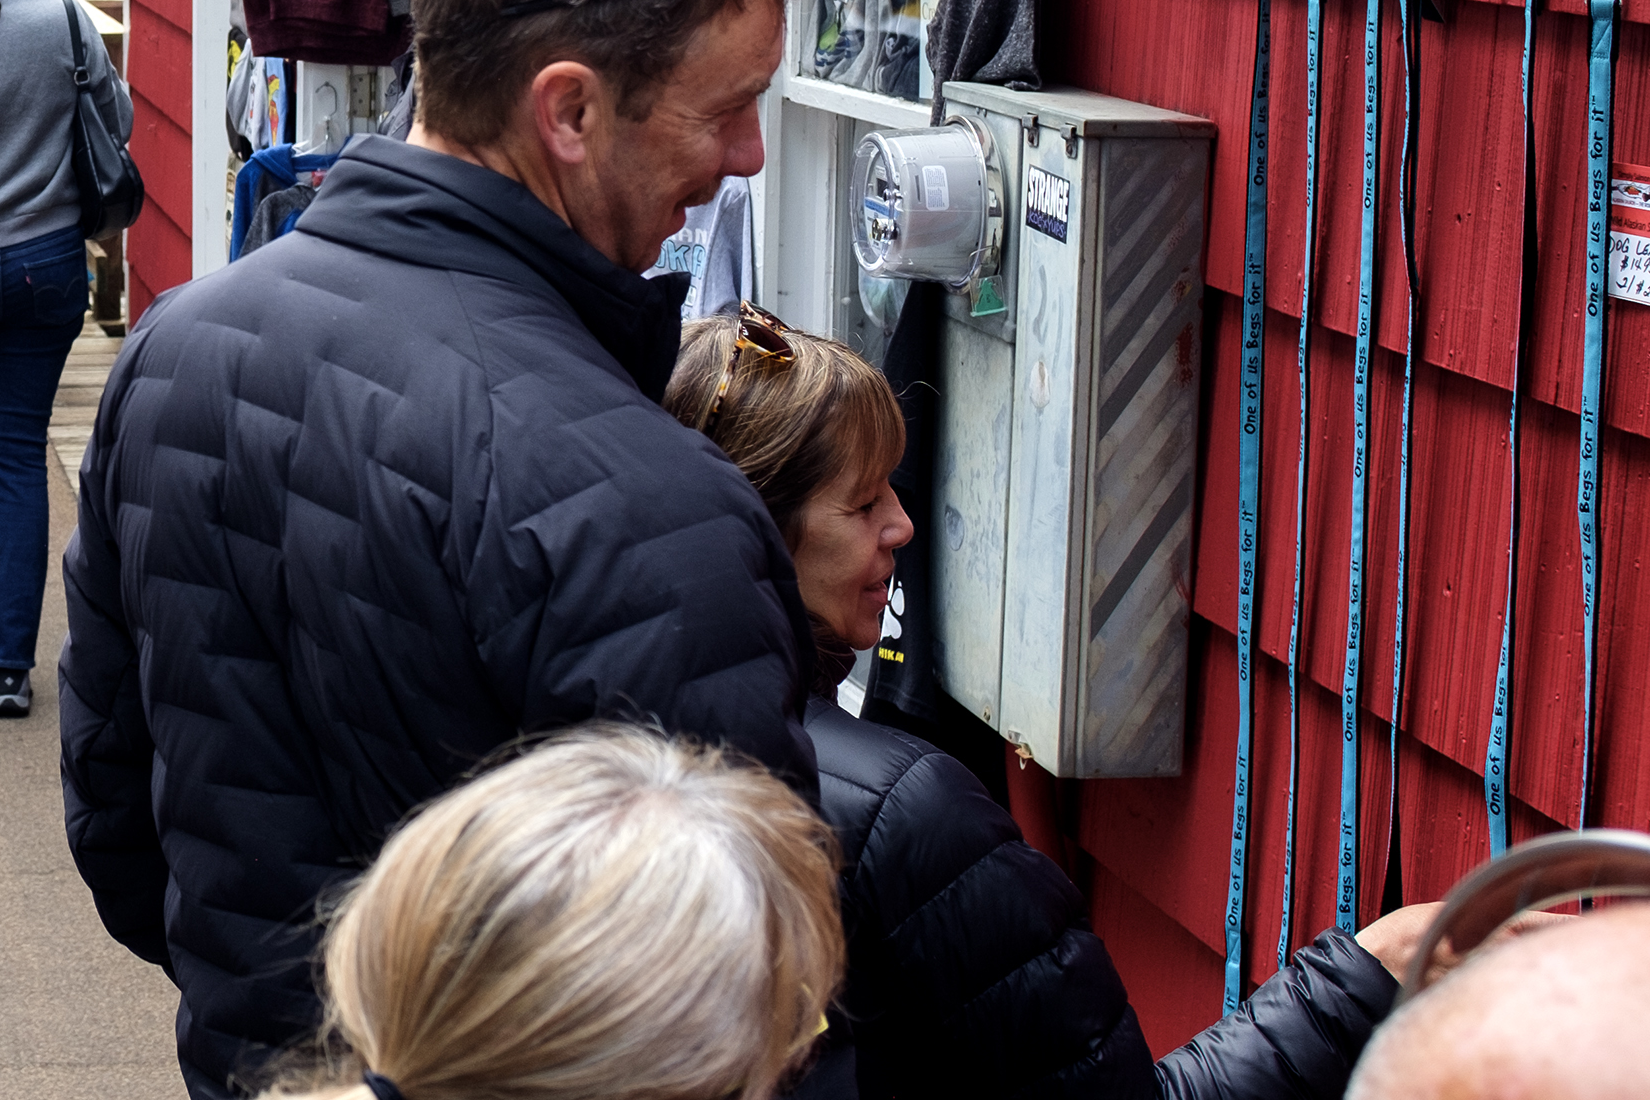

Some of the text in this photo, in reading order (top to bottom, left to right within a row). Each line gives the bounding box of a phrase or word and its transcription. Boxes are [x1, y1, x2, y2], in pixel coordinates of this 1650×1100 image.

[1365, 40, 1374, 66] for
[1366, 76, 1375, 114] Begs
[1365, 122, 1373, 141] us
[1590, 131, 1604, 160] for
[1365, 151, 1373, 170] of
[1028, 166, 1070, 223] STRANGE
[1364, 178, 1372, 208] One
[1590, 169, 1604, 212] Begs
[1590, 222, 1601, 242] us
[1589, 251, 1600, 274] of
[1247, 281, 1260, 306] for
[1587, 283, 1599, 317] One
[1246, 312, 1260, 349] Begs
[1359, 311, 1367, 337] for
[1246, 356, 1258, 374] us
[1357, 346, 1366, 384] Begs
[1245, 382, 1257, 399] of
[1356, 393, 1364, 412] us
[1244, 406, 1256, 434] One
[1356, 421, 1364, 439] of
[1581, 432, 1593, 461] for
[1354, 447, 1363, 478] One
[1579, 470, 1593, 513] Begs
[1242, 529, 1253, 554] for
[1581, 523, 1591, 544] us
[1584, 551, 1592, 575] of
[1241, 561, 1253, 596] Begs
[1351, 580, 1359, 605] for
[1584, 582, 1592, 616] One
[1241, 603, 1249, 620] us
[1240, 629, 1248, 646] of
[1348, 613, 1359, 649] Begs
[1240, 652, 1248, 681] One
[1346, 658, 1355, 677] us
[1344, 685, 1354, 704] of
[1345, 712, 1354, 742] One
[1494, 726, 1503, 746] us
[1489, 754, 1500, 775] of
[1236, 774, 1245, 796] for
[1490, 783, 1501, 815] One
[1233, 805, 1245, 840] Begs
[1233, 848, 1242, 866] us
[1341, 843, 1352, 867] for
[1230, 872, 1240, 891] of
[1339, 876, 1352, 914] Begs
[1228, 898, 1239, 926] One
